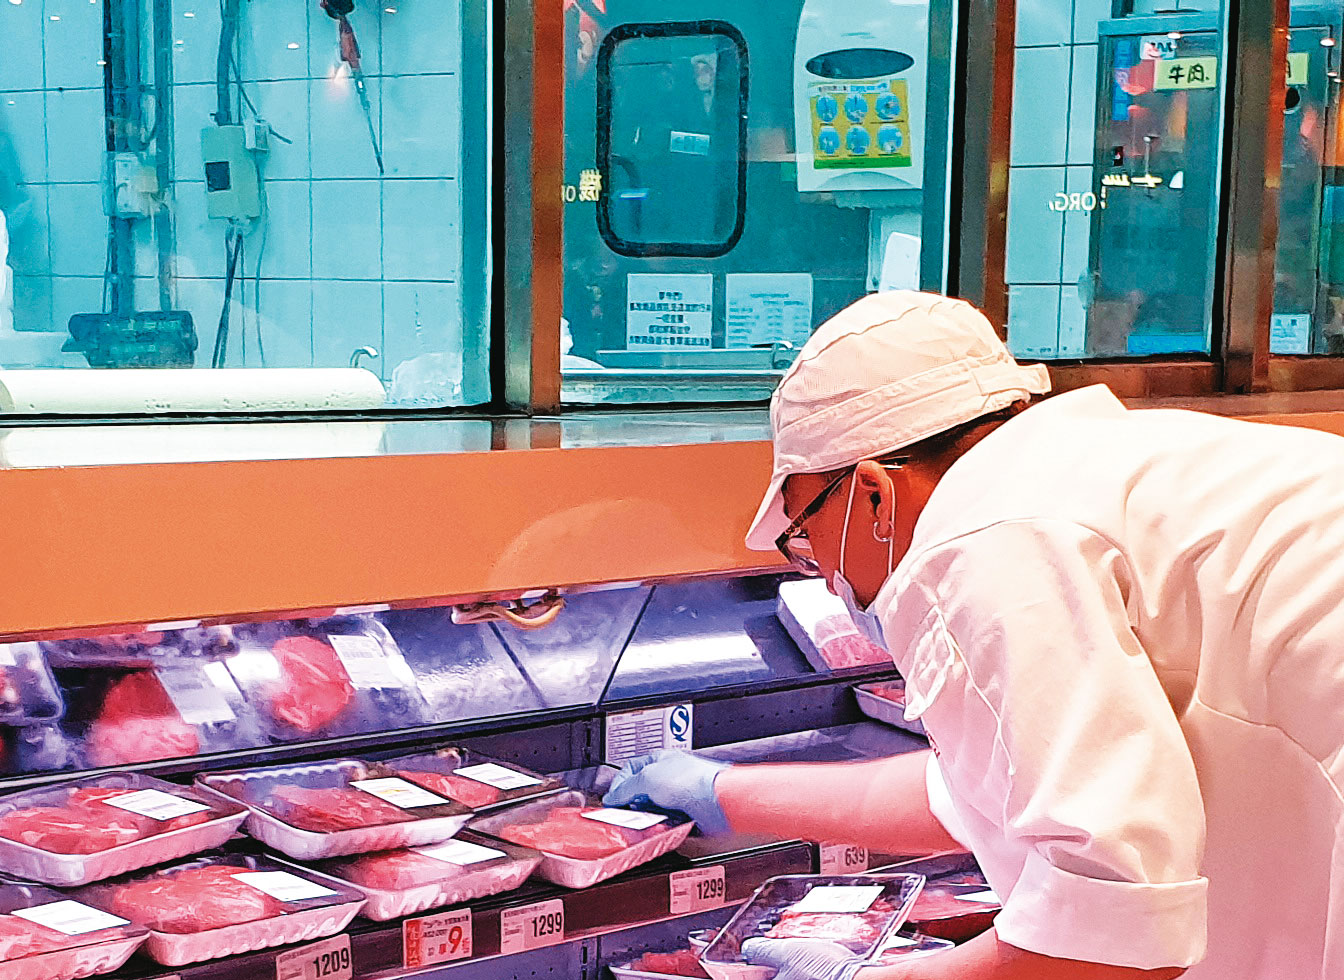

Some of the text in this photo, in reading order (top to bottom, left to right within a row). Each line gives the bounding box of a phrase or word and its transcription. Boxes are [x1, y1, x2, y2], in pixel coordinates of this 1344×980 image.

[844, 846, 866, 866] 639
[697, 877, 724, 900] 1299
[532, 912, 563, 937] 1299
[448, 925, 463, 954] 9
[313, 947, 350, 978] 1209
